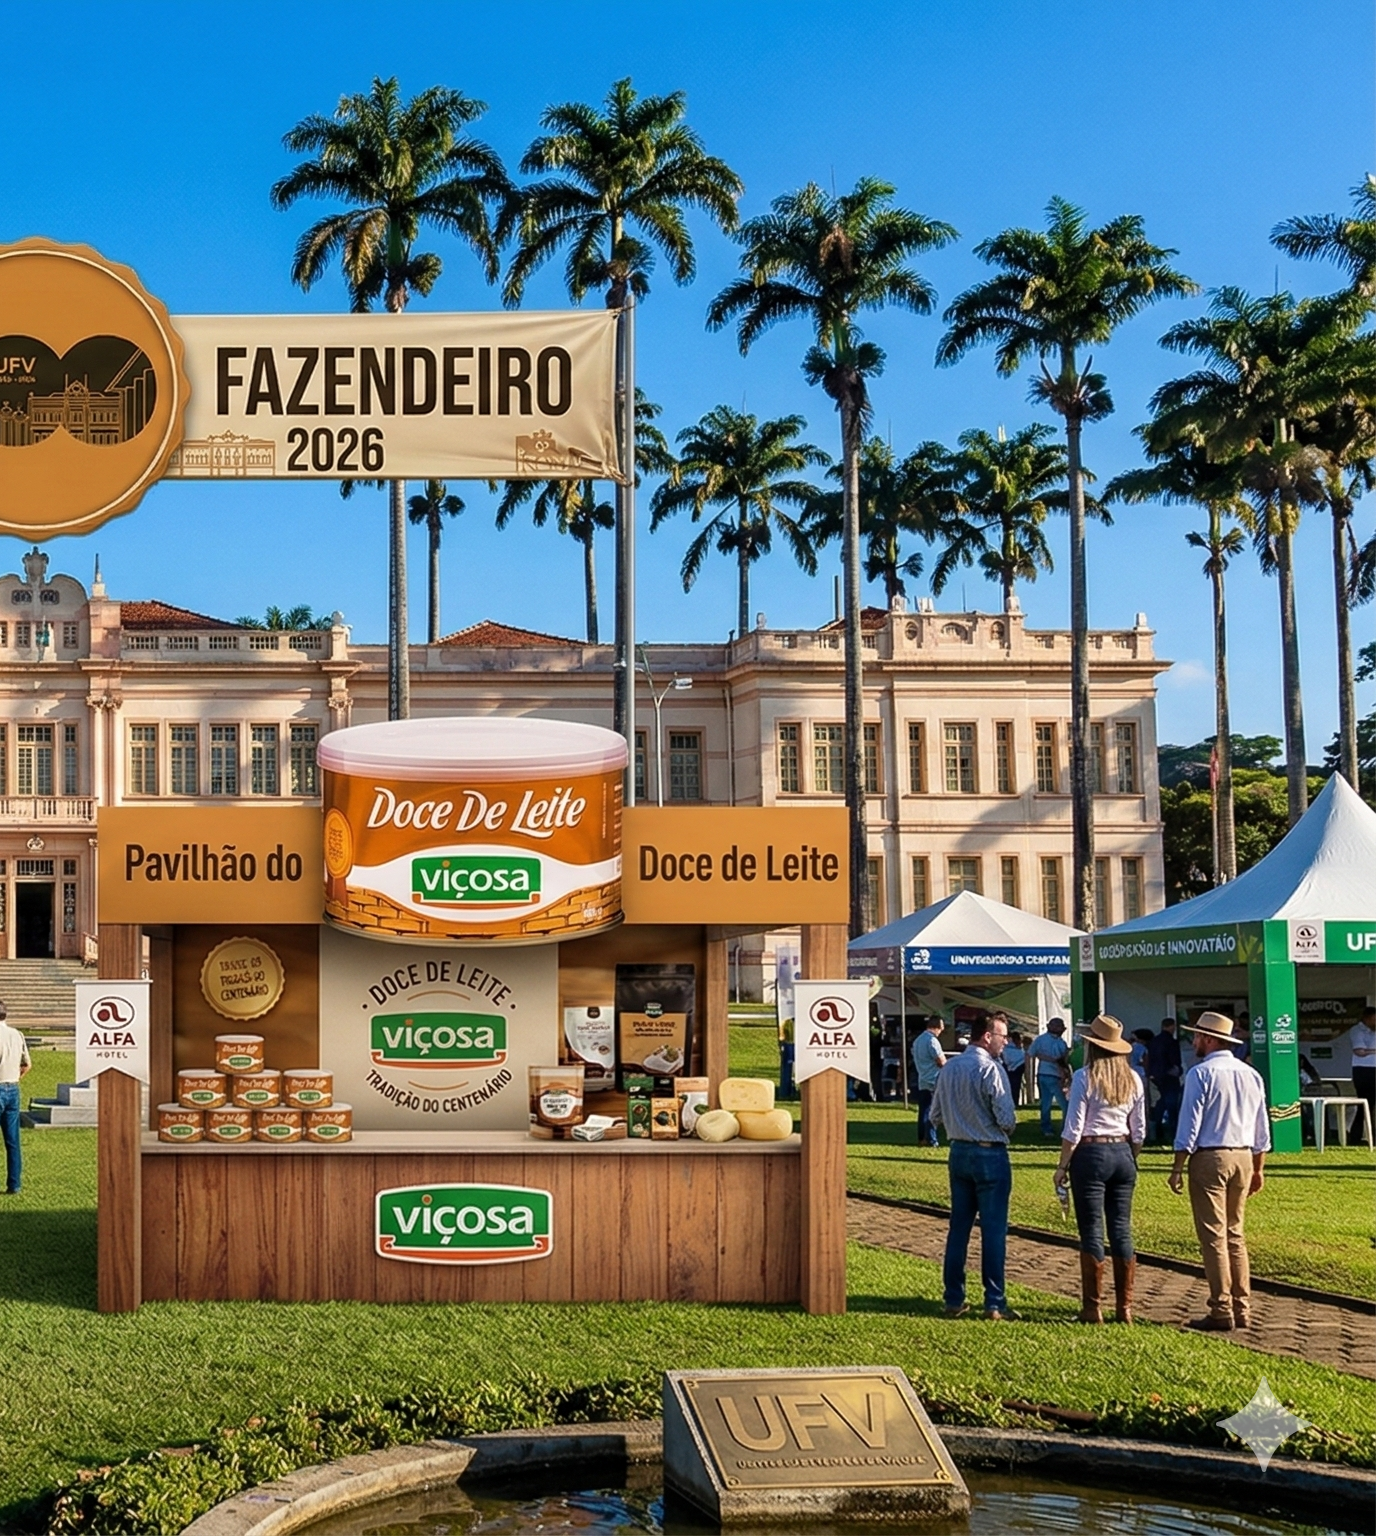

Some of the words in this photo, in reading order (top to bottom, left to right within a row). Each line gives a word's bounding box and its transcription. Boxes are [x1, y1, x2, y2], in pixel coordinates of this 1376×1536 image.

[216, 346, 572, 417] FAZENDEIRO
[286, 427, 385, 472] 2026
[367, 787, 453, 830] Doce
[455, 790, 508, 832] De
[510, 786, 587, 838] Leite
[125, 843, 257, 882] Pavilhão
[266, 843, 303, 882] do
[639, 844, 713, 882] Doce
[721, 844, 757, 882] de
[767, 844, 839, 882] Leite
[368, 963, 422, 1006] DOCE
[426, 961, 451, 982] DE
[456, 963, 512, 1006] LEITE
[89, 1032, 136, 1046] ALFA
[96, 1051, 128, 1059] HOTEL
[808, 1032, 856, 1046] ALFA
[816, 1051, 848, 1059] HOTEL
[365, 1068, 420, 1111] TRADIÇÃO
[422, 1098, 439, 1113] DO
[442, 1068, 513, 1113] CENTENÁRIO
[715, 1391, 887, 1451] UFV
